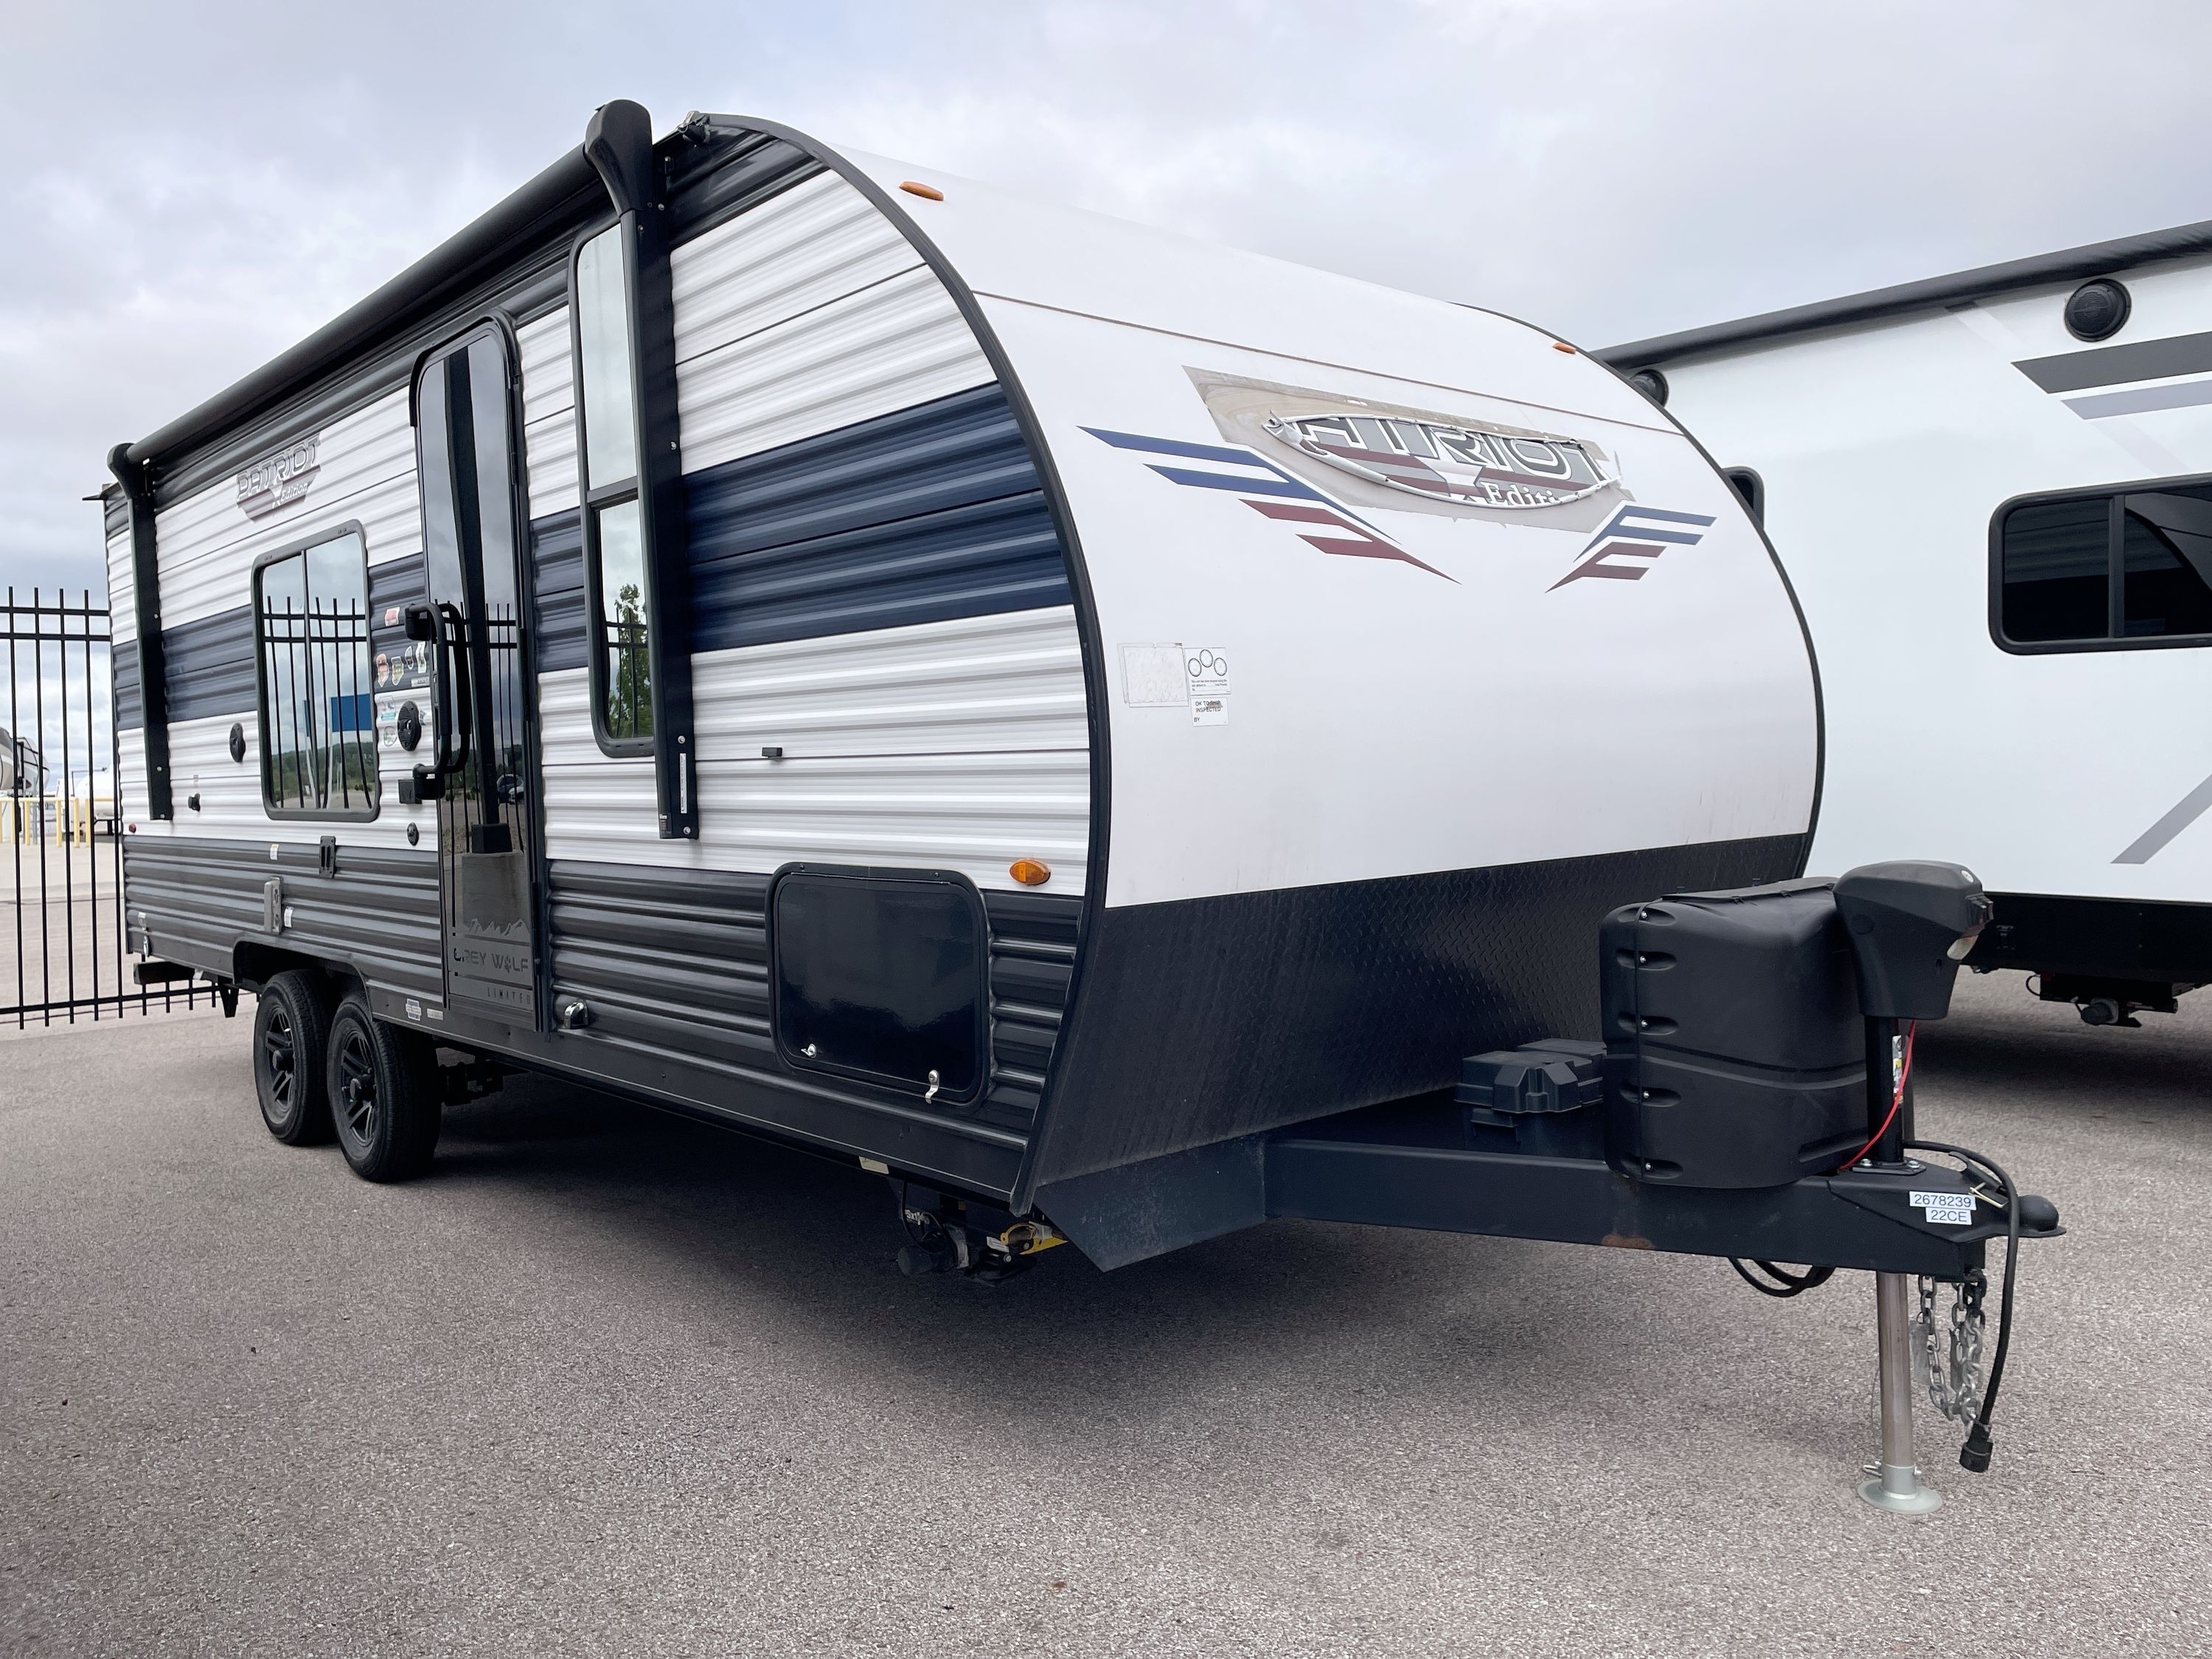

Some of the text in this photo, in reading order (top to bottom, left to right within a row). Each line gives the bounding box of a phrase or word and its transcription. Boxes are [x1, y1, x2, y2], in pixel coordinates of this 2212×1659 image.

[236, 433, 321, 501] PATRIOT
[281, 482, 308, 501] Edition
[487, 987, 531, 1004] LIMITED
[1914, 1194, 1972, 1207] 2678239
[1931, 1209, 1967, 1222] 22CE
